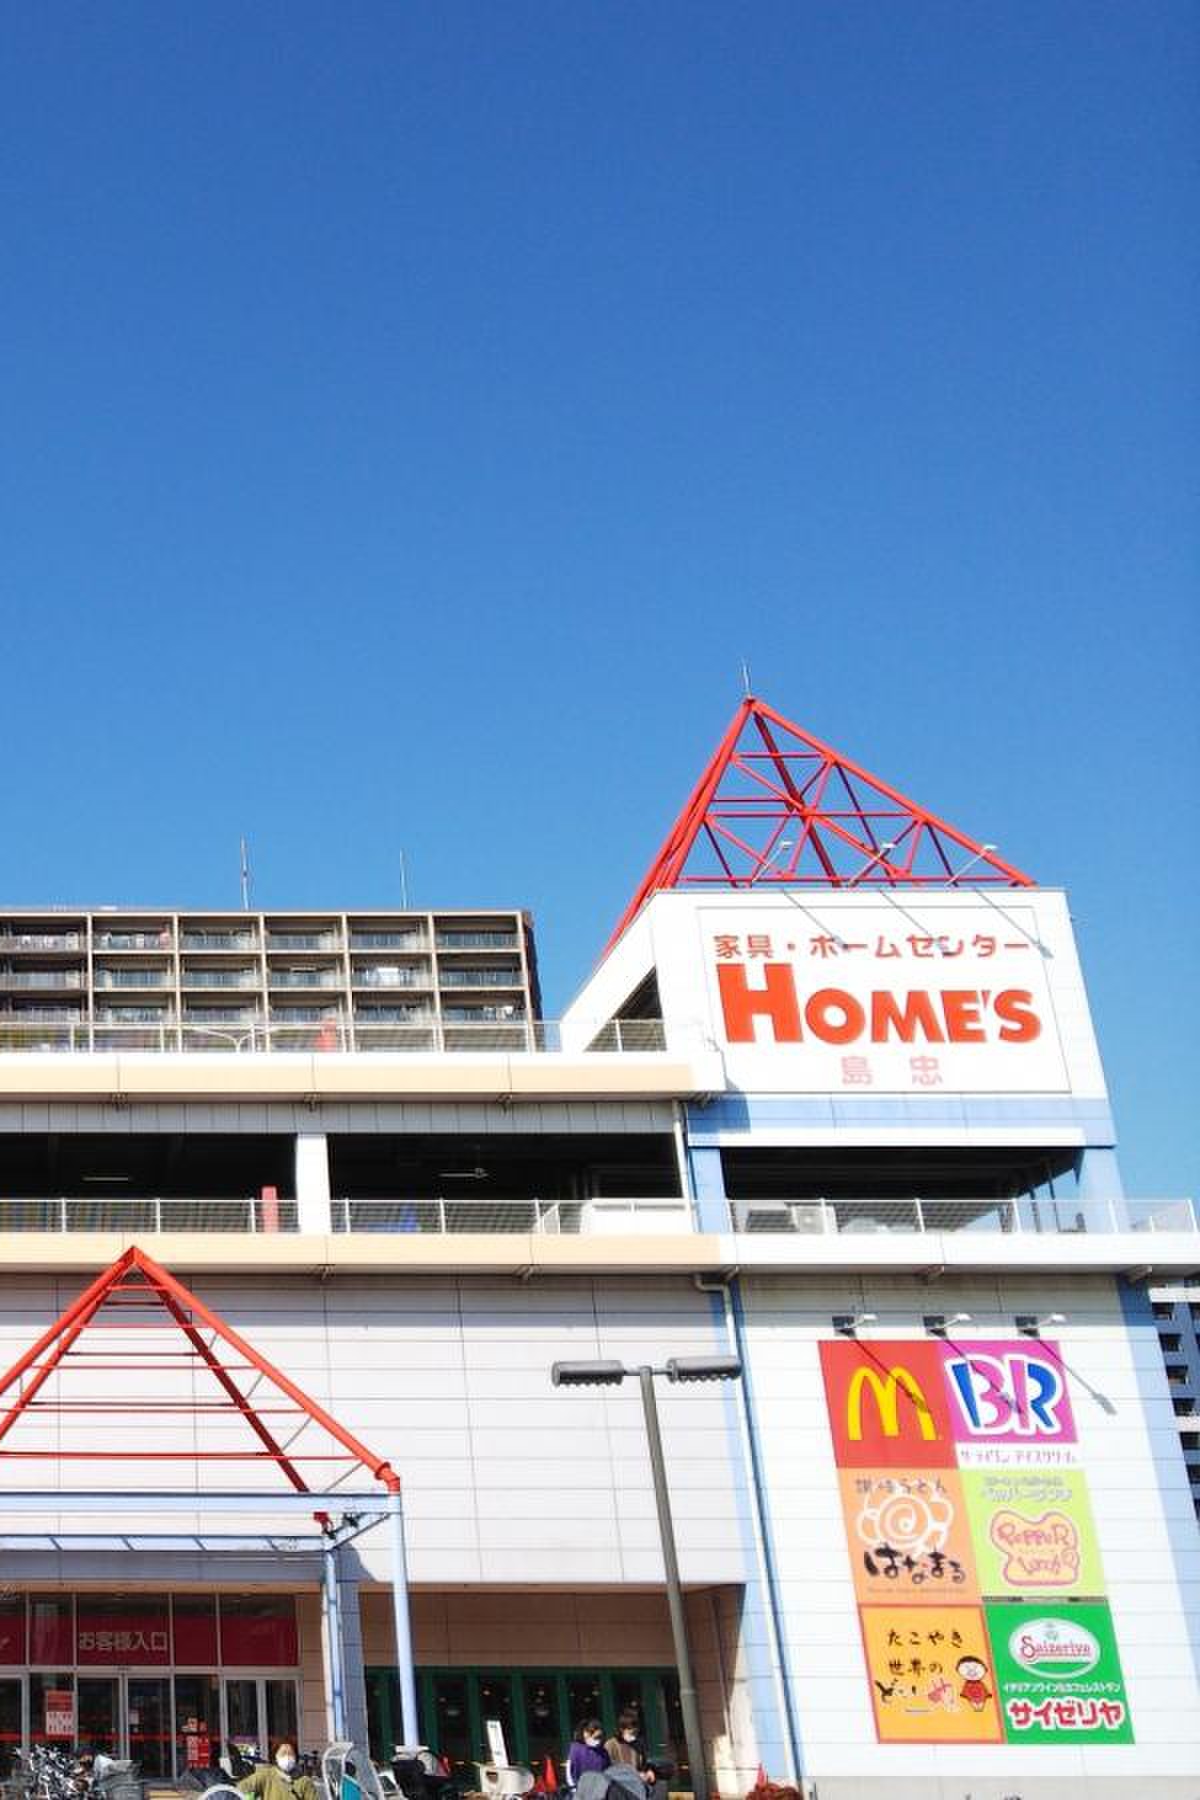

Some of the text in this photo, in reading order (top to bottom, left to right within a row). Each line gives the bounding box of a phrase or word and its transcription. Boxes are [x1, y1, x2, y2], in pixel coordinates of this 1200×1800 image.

[714, 934, 1030, 959] 家具・ホームセンター
[716, 962, 1042, 1044] HOME'S
[79, 1631, 168, 1651] お客様入口
[887, 1629, 964, 1649] たこやき
[888, 1658, 944, 1677] 世界の
[1008, 1700, 1123, 1727] サイゼリヤ
